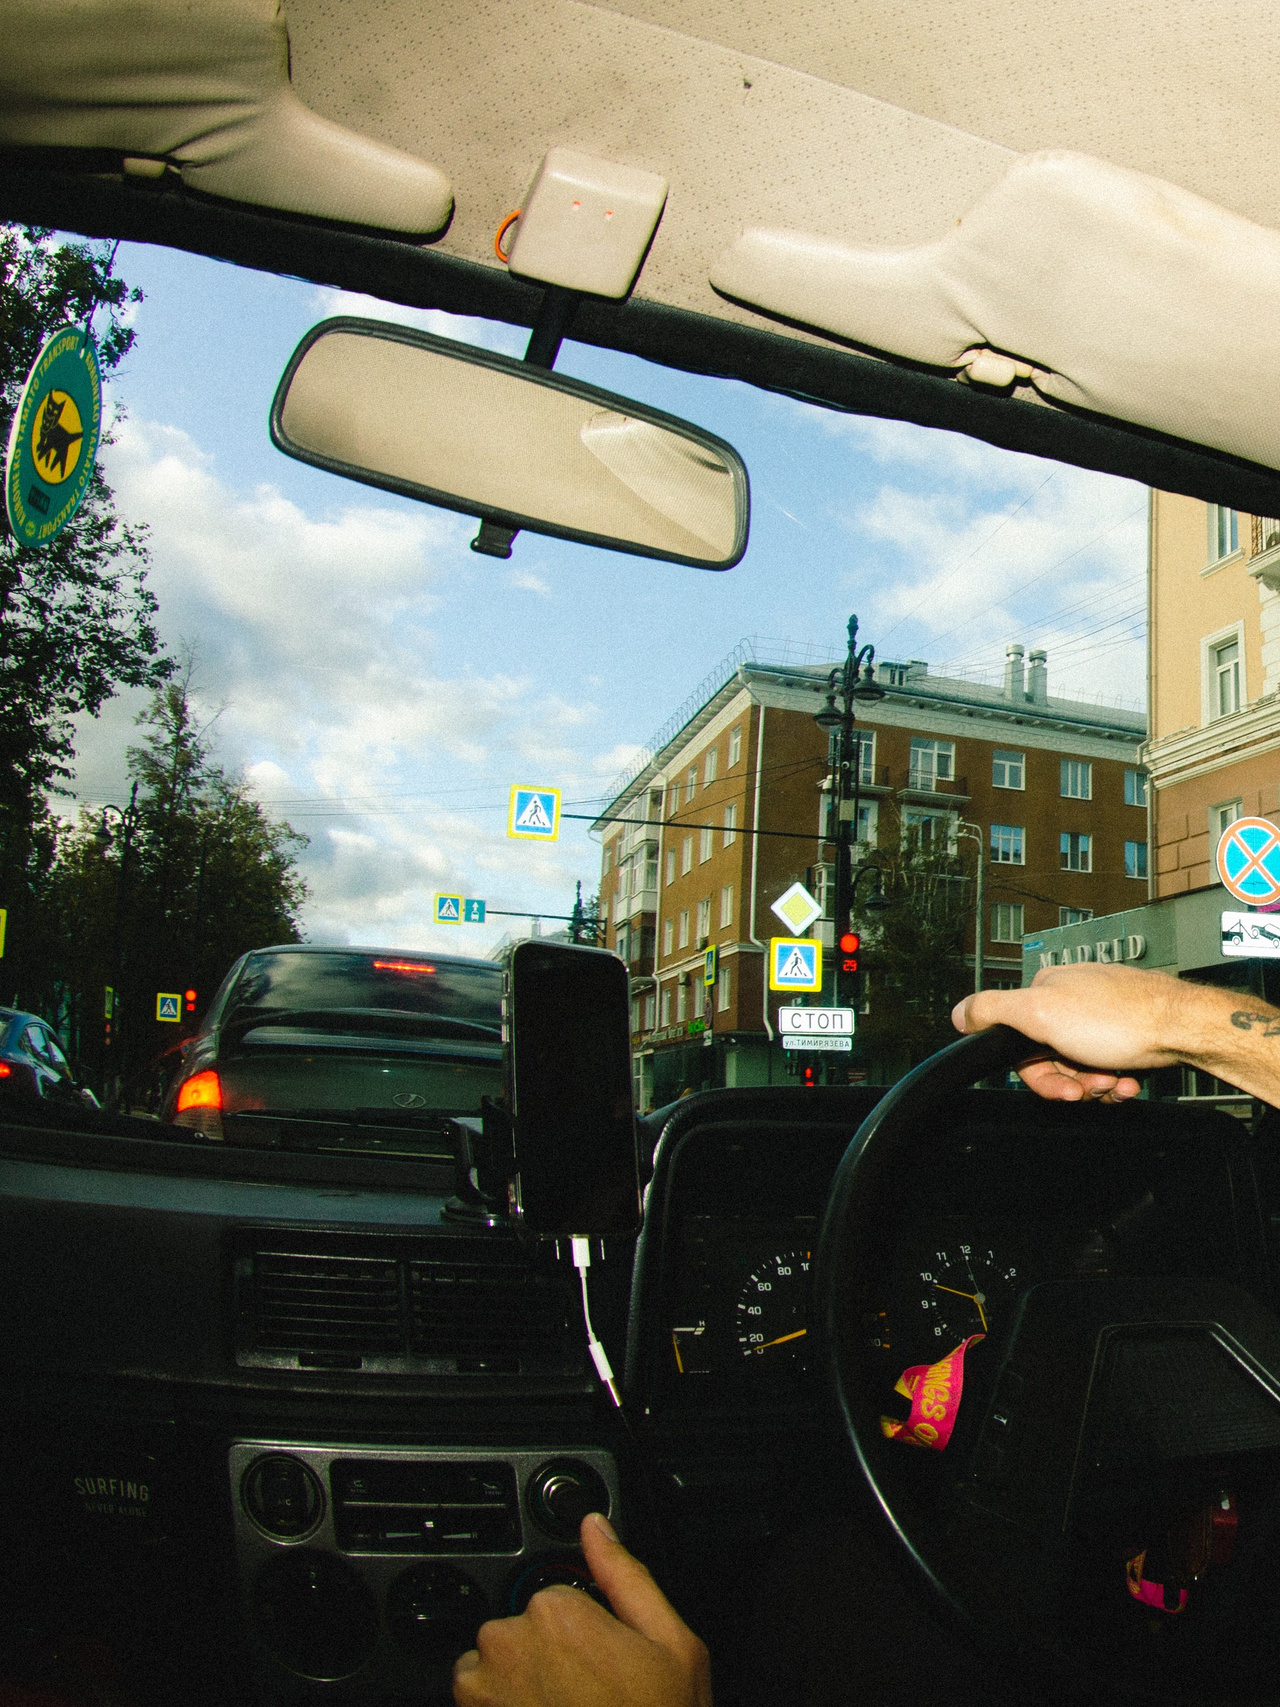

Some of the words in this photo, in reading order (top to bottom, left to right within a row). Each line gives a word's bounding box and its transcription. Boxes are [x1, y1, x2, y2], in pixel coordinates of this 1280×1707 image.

[17, 378, 39, 443] YAMATO
[39, 335, 79, 378] TRANSPORT
[79, 427, 98, 487] YAMATO
[37, 488, 79, 539] TRANSPORT
[843, 959, 857, 971] 29
[791, 1013, 843, 1029] СТОП
[959, 1245, 972, 1254] 12
[988, 1250, 994, 1259] 1
[936, 1252, 948, 1261] 11
[777, 1266, 792, 1276] 80
[1009, 1268, 1017, 1277] 2
[919, 1272, 932, 1282] 10
[757, 1282, 772, 1292] 60
[921, 1300, 929, 1309] 9
[747, 1306, 762, 1315] 40
[934, 1327, 942, 1336] 8
[749, 1333, 764, 1343] 20
[73, 1476, 149, 1502] SURFING
